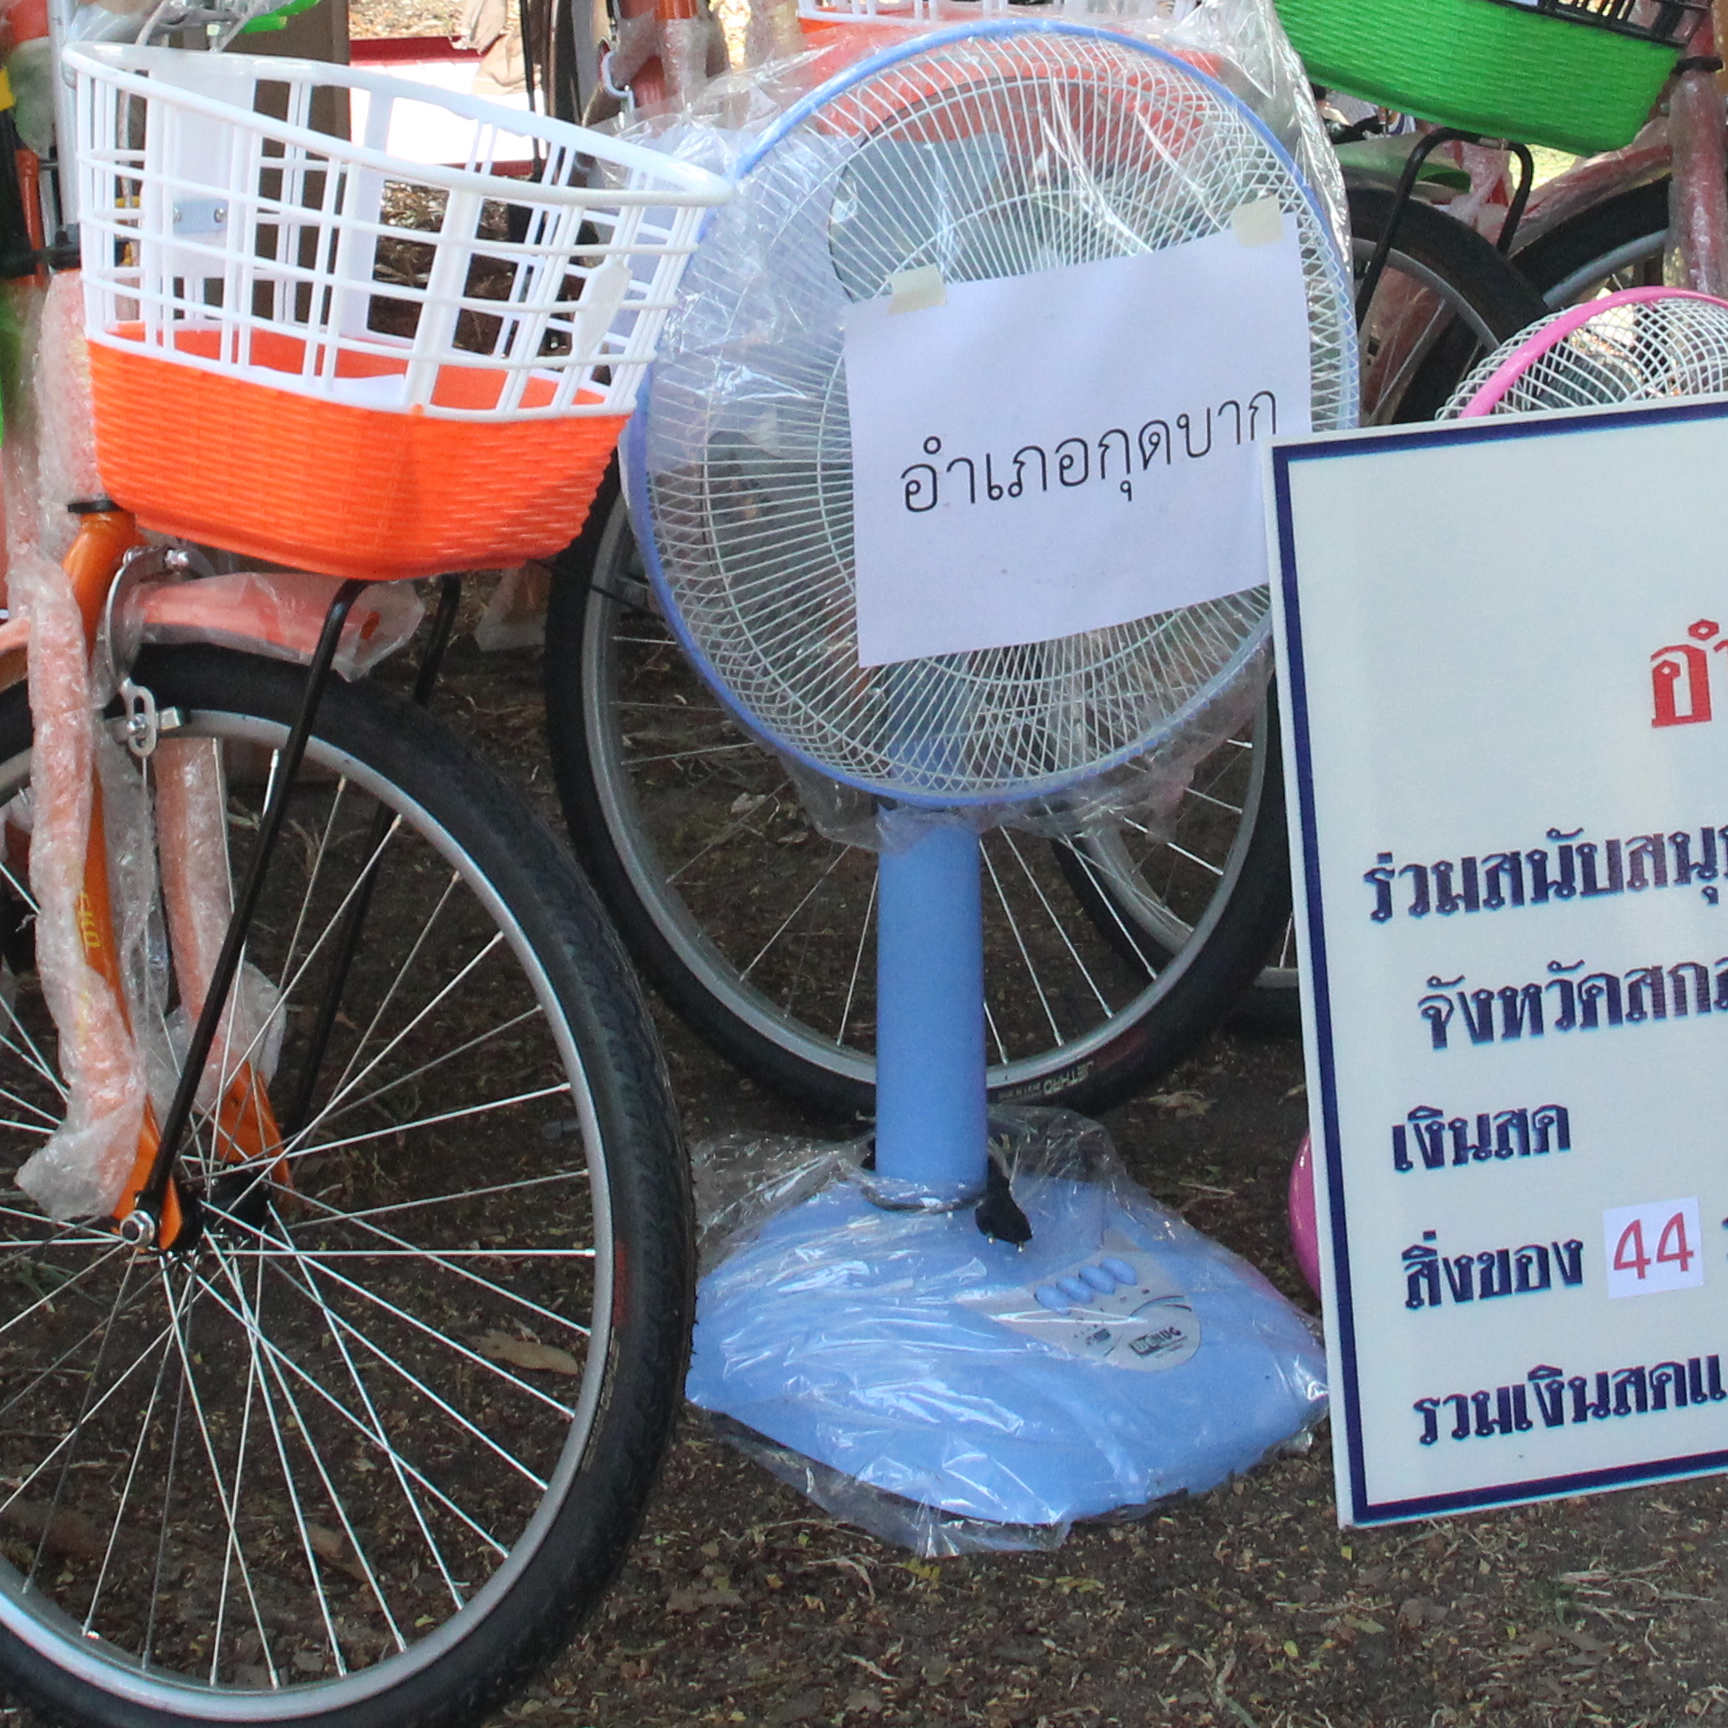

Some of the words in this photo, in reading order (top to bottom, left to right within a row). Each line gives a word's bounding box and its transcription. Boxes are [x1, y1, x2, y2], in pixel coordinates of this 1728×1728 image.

[900, 390, 1277, 513] อำเภอกุดบาก
[1391, 1103, 1572, 1174] เงินสด
[1401, 1230, 1585, 1311] สิ่งของ
[1612, 1210, 1695, 1282] 44
